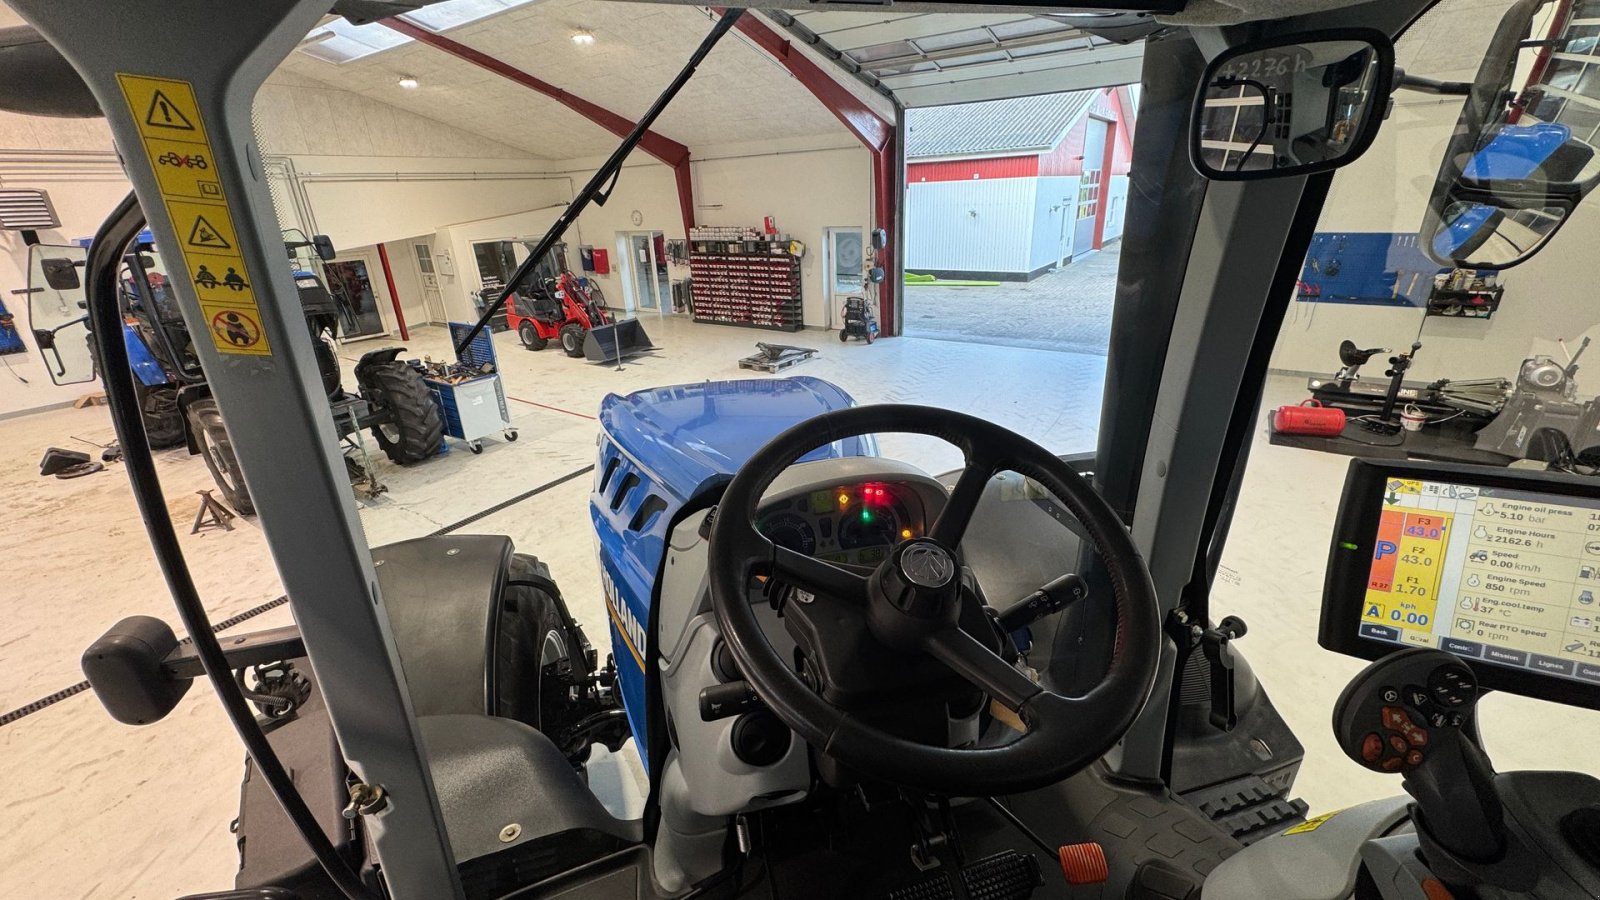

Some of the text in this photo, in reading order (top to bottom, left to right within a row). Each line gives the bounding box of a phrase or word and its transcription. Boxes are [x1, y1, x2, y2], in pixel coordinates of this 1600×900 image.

[1502, 503, 1532, 511] Engine
[1418, 518, 1431, 526] F3
[1500, 512, 1546, 523] 5.10 bar
[1407, 526, 1438, 538] 43.0
[1496, 526, 1556, 539] Engine Hours
[1494, 536, 1543, 548] 2162.6 h
[1375, 540, 1397, 560] P
[1412, 546, 1425, 554] F2
[1492, 550, 1518, 559] Speed
[1402, 554, 1432, 567] 43.0
[1490, 559, 1541, 573] 0.00 km/h
[1406, 576, 1419, 584] F1
[1487, 574, 1546, 588] Engine Speed
[1396, 584, 1425, 596] 1.70
[1485, 583, 1530, 596] 850 rpm
[1367, 606, 1380, 617] A
[1400, 602, 1416, 610] kph
[1390, 610, 1428, 625] 0.00
[1499, 609, 1511, 617] °C
[1488, 632, 1508, 640] rpm
[1500, 624, 1518, 632] PTO
[1520, 629, 1547, 637] speed
[1491, 650, 1518, 660] Mission
[1538, 660, 1564, 669] Lignes
